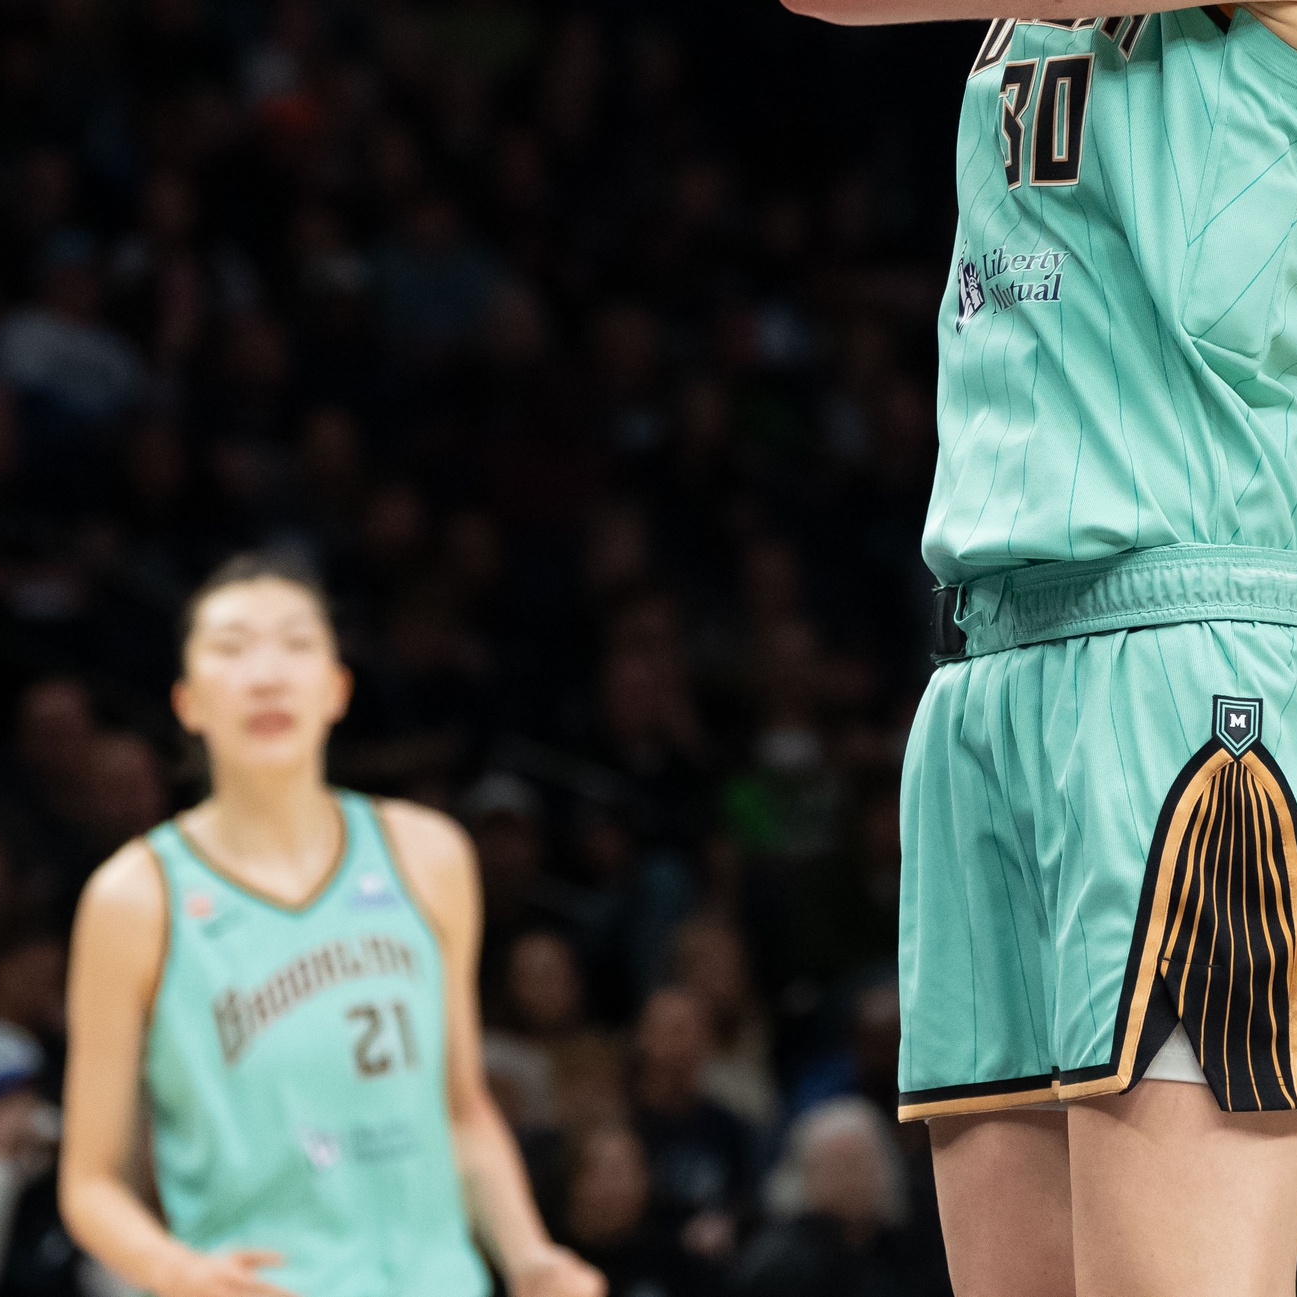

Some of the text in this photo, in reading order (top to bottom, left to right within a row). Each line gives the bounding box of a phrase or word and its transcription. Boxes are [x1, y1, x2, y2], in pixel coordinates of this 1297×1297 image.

[983, 245, 1069, 282] Liberty
[990, 273, 1062, 316] Mutual
[1229, 713, 1247, 729] M
[344, 998, 420, 1082] 21
